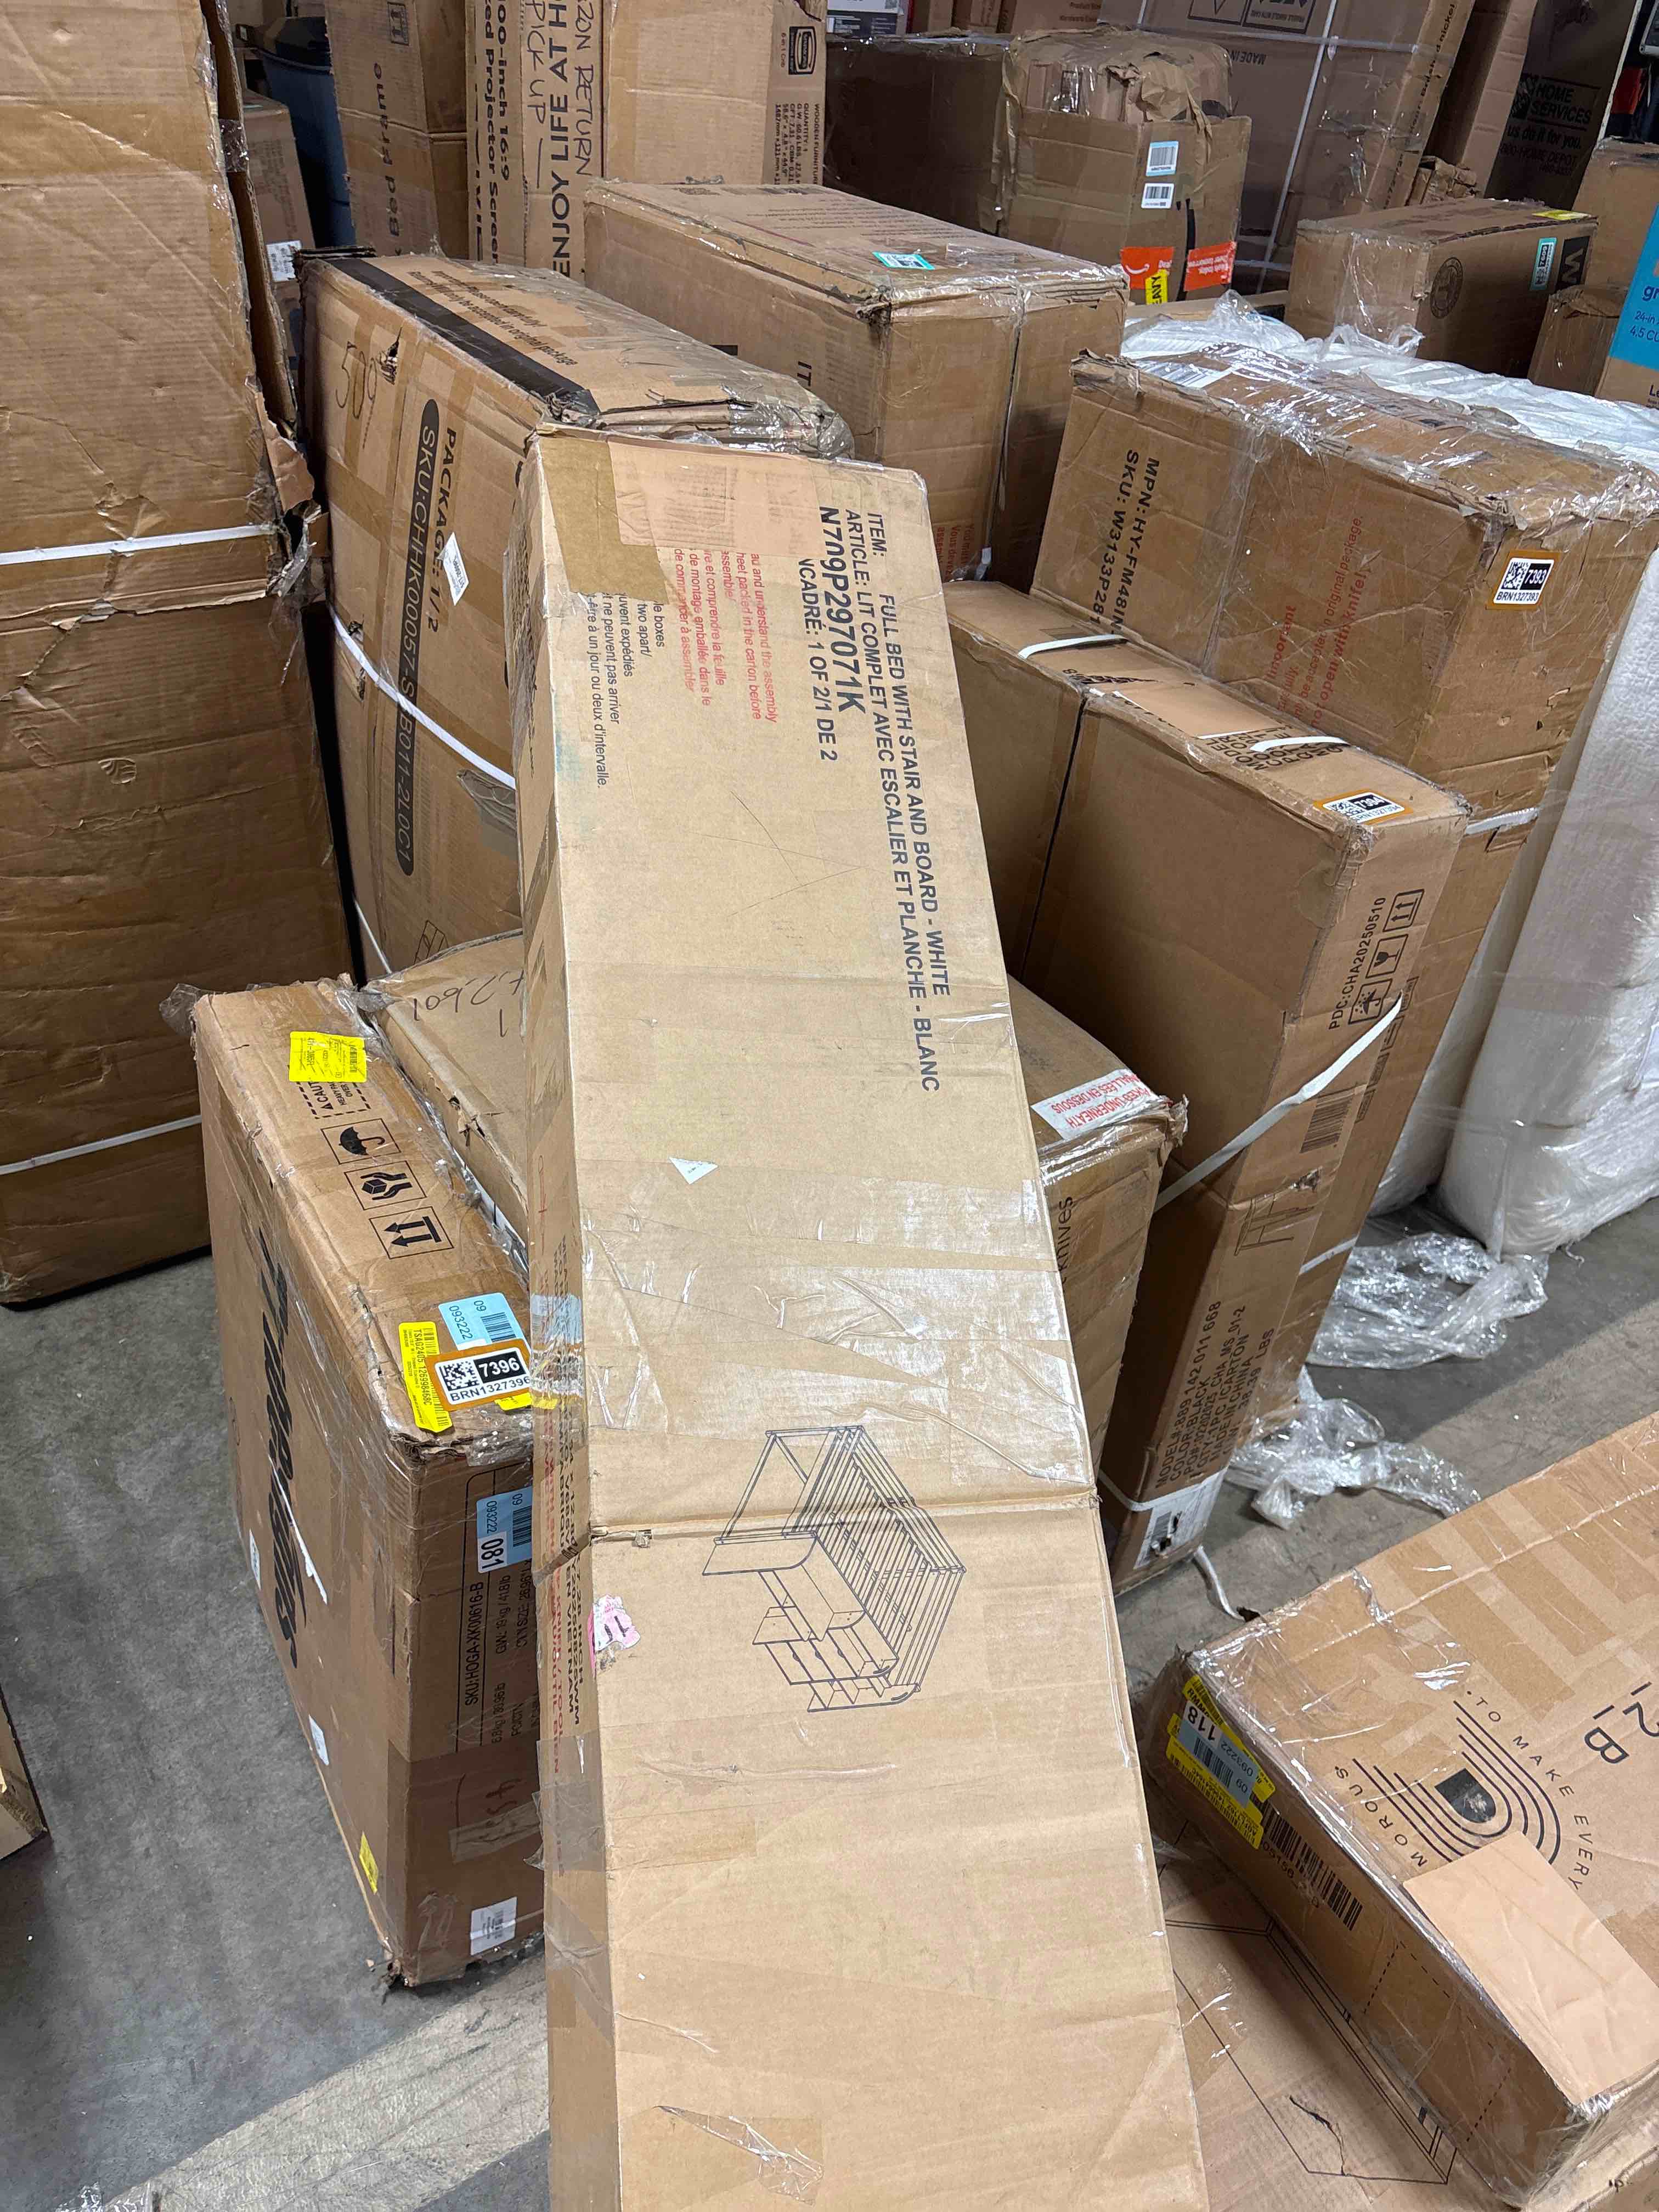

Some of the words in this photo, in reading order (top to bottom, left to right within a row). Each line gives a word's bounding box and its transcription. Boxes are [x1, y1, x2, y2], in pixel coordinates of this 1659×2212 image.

[526, 0, 546, 70] PICK
[549, 37, 568, 83] AT
[529, 78, 546, 125] UP
[1536, 83, 1574, 103] HOME
[374, 62, 393, 166] Frame
[484, 48, 496, 175] Projector
[549, 94, 569, 161] LIFE
[573, 64, 594, 177] RETURN
[1530, 99, 1592, 124] SERVICES
[500, 125, 510, 180] 16:9
[385, 174, 400, 238] Bed
[551, 170, 572, 278] ENJOY
[1116, 448, 1139, 503] SKU:
[845, 509, 872, 586] ARTICLE:
[867, 512, 888, 558] ITEM:
[674, 548, 685, 562] de
[689, 553, 698, 566] de
[737, 551, 747, 574] heet
[690, 569, 702, 613] montage
[1326, 570, 1345, 617] original
[1525, 568, 1547, 585] 7393
[604, 601, 613, 616] ne
[619, 593, 630, 626] uvent
[637, 603, 647, 623] two
[653, 600, 663, 614] le
[706, 575, 721, 640] comprendre
[798, 557, 828, 635] NCADRÉ:
[856, 590, 875, 618] LIT
[1496, 591, 1539, 603] BRN1327393
[654, 616, 665, 647] boxes
[743, 614, 752, 625] in
[879, 593, 899, 638] FULL
[397, 424, 437, 862] SKU:CHHK00057-SB011-2L0C1
[588, 635, 597, 648] un
[601, 618, 616, 662] peuvent
[621, 628, 633, 678] expédiés
[636, 625, 652, 658] apart/
[712, 641, 720, 651] la
[744, 627, 754, 646] the
[807, 642, 825, 650] 1
[586, 649, 600, 674] jour
[607, 663, 618, 685] pas
[809, 656, 829, 682] OF
[861, 621, 888, 709] COMPLET
[886, 644, 906, 681] BED
[591, 676, 600, 690] ou
[763, 670, 777, 723] assembly
[1319, 658, 1340, 702] open
[592, 693, 603, 721] deux
[608, 686, 620, 724] arriver
[702, 696, 711, 707] le
[749, 683, 761, 721] before
[812, 685, 833, 712] 2/1
[891, 685, 914, 731] WITH
[816, 717, 837, 745] DE
[873, 711, 895, 763] AVEC
[594, 723, 607, 788] d'intervalle.
[820, 749, 838, 762] 2
[899, 735, 921, 791] STAIR
[1205, 737, 1268, 771] MODEL
[879, 766, 910, 865] ESCALIER
[906, 793, 928, 837] AND
[1355, 796, 1386, 810] 7394
[894, 869, 913, 896] ET
[913, 840, 939, 914] BOARD
[897, 900, 928, 1000] PLANCHE
[926, 929, 951, 997] WHITE
[1328, 896, 1387, 1030] PDC:CHA20250510
[912, 1017, 940, 1092] BLANC
[307, 1081, 329, 1103] CAUT
[340, 1083, 353, 1098] OVER
[1051, 1092, 1090, 1114] DESSOUS
[1065, 1096, 1124, 1128] UNDERNEATH
[448, 1305, 474, 1340] 093222
[473, 1299, 487, 1312] 09
[1203, 1300, 1222, 1332] 668
[1193, 1335, 1212, 1364] 011
[1255, 1327, 1276, 1359] LBS
[478, 1357, 521, 1379] 7396
[1184, 1365, 1203, 1396] 142
[450, 1374, 532, 1403] BRN1327396
[486, 1499, 498, 1534] 093222
[512, 1493, 523, 1506] 09
[480, 1536, 504, 1570] 081
[465, 1581, 484, 1706] SKU:HOGA-XK00616-B
[567, 1604, 575, 1714] VIETNAM
[1187, 1704, 1216, 1742] 118
[1220, 1740, 1255, 1778] 093222
[1235, 1779, 1249, 1795] 09
[1475, 1697, 1503, 1724] TO
[1511, 1734, 1575, 1798] MAKE
[1565, 1813, 1590, 1893] EVERY
[1335, 1764, 1427, 1868] MOROUS
